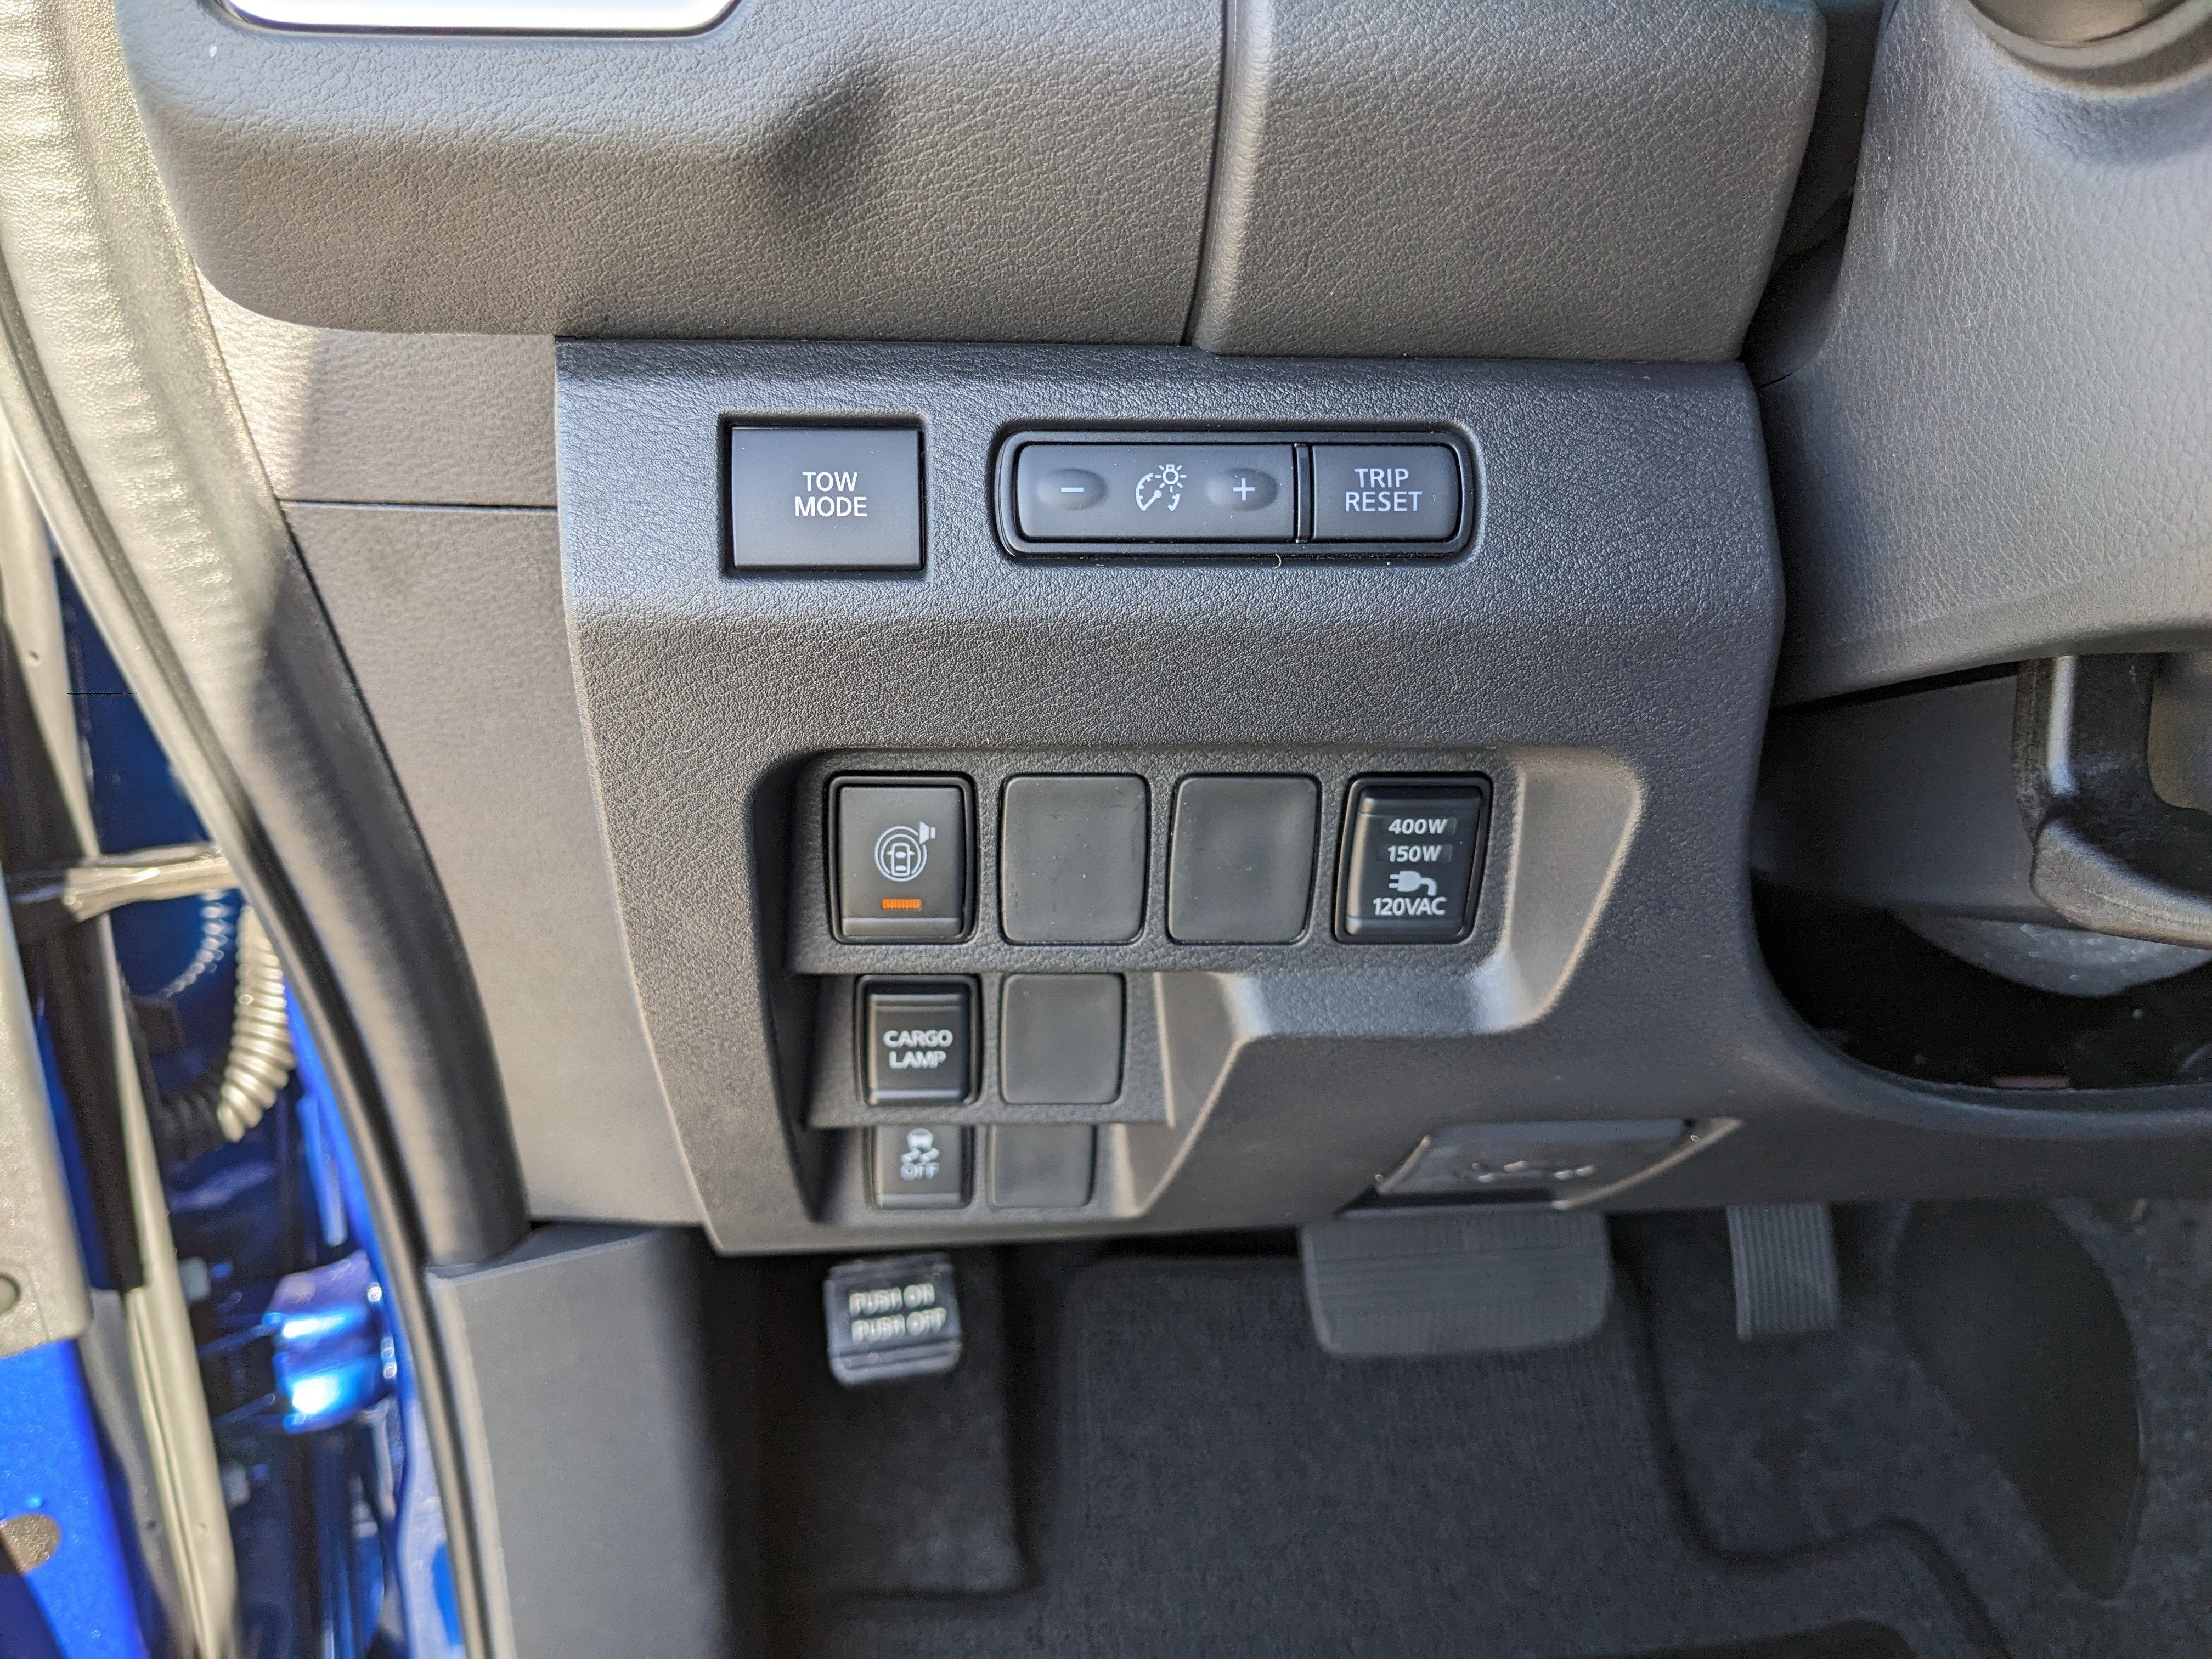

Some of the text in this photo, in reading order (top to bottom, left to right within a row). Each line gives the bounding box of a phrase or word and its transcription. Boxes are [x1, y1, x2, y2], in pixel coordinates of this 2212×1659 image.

[802, 471, 858, 492] TOW
[1354, 468, 1409, 488] TRIP
[794, 496, 868, 517] MODE
[1345, 490, 1423, 512] RESET
[1387, 818, 1449, 835] 400W
[1387, 844, 1443, 863] 150W
[1372, 896, 1448, 916] 120VAC
[883, 1029, 953, 1048] CARGO
[889, 1049, 947, 1069] LAMP
[849, 1282, 936, 1317] PUSH ON
[851, 1307, 947, 1345] PUSH OFF
